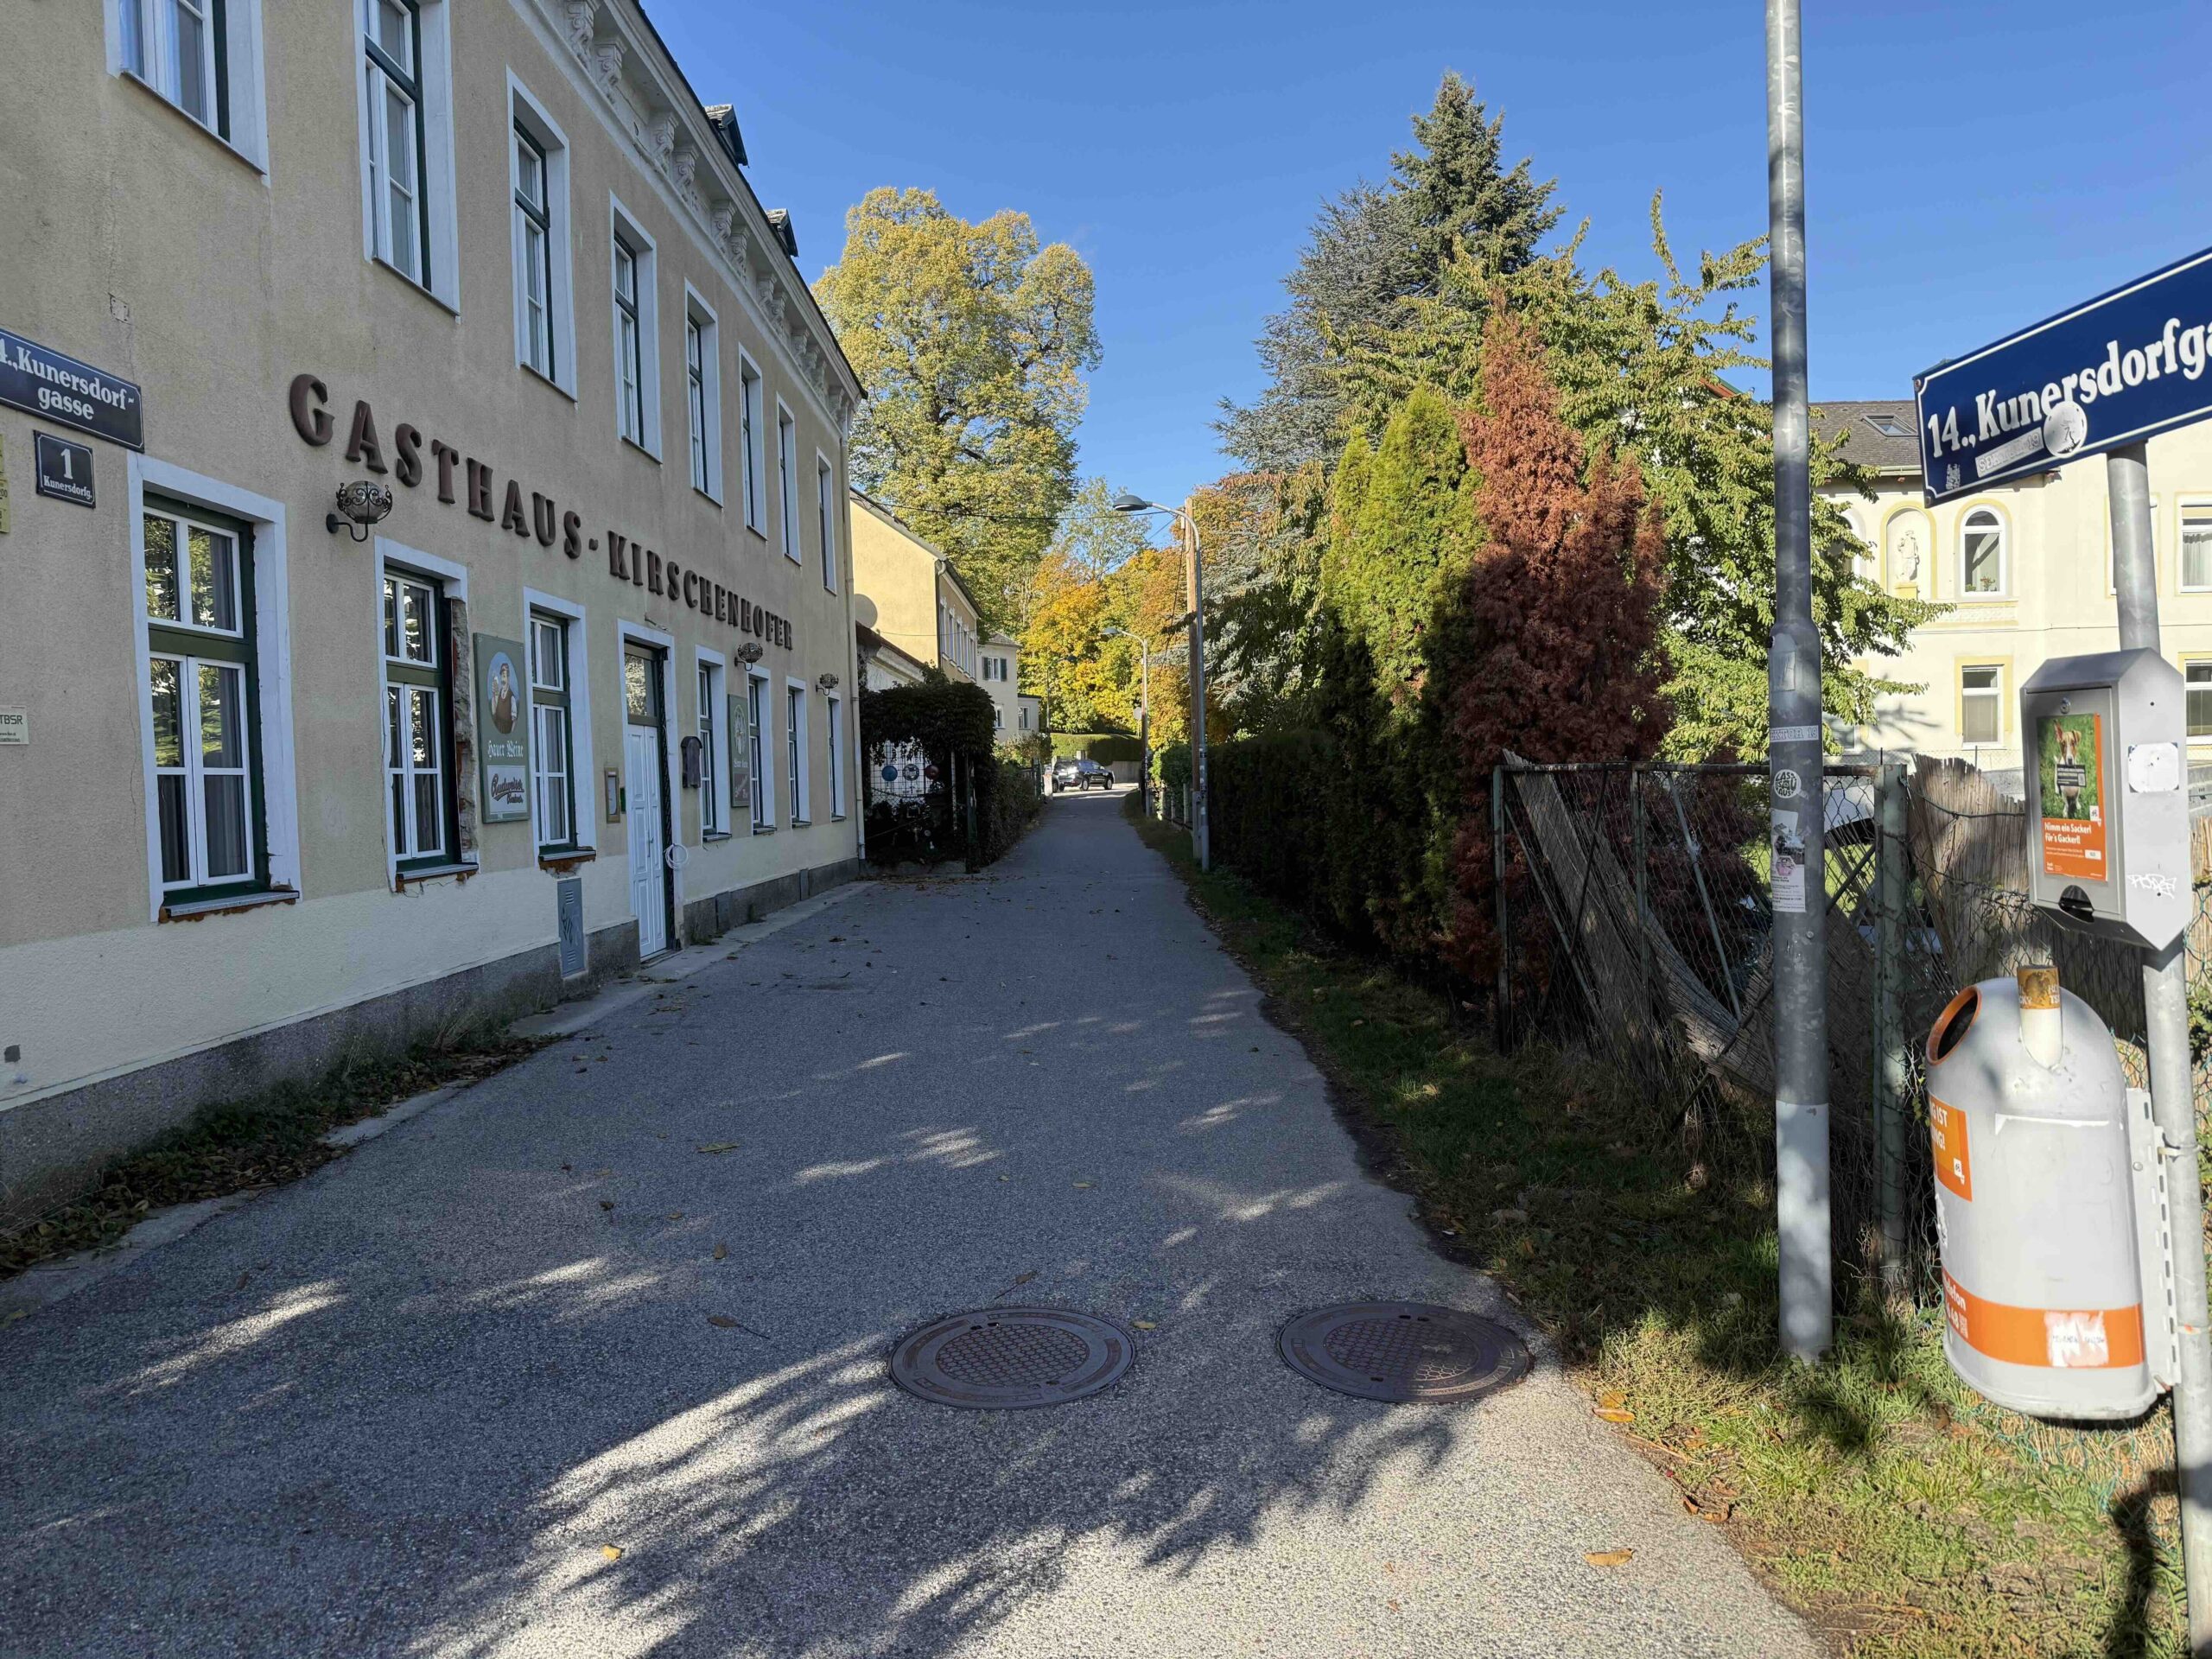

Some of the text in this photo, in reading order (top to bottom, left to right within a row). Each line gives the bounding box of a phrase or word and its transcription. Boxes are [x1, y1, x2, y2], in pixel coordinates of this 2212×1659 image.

[37, 387, 94, 420] gasse
[60, 448, 73, 480] 1
[43, 474, 92, 500] Kunersdorfg.
[2044, 822, 2060, 832] Nimm
[2062, 823, 2070, 833] ein
